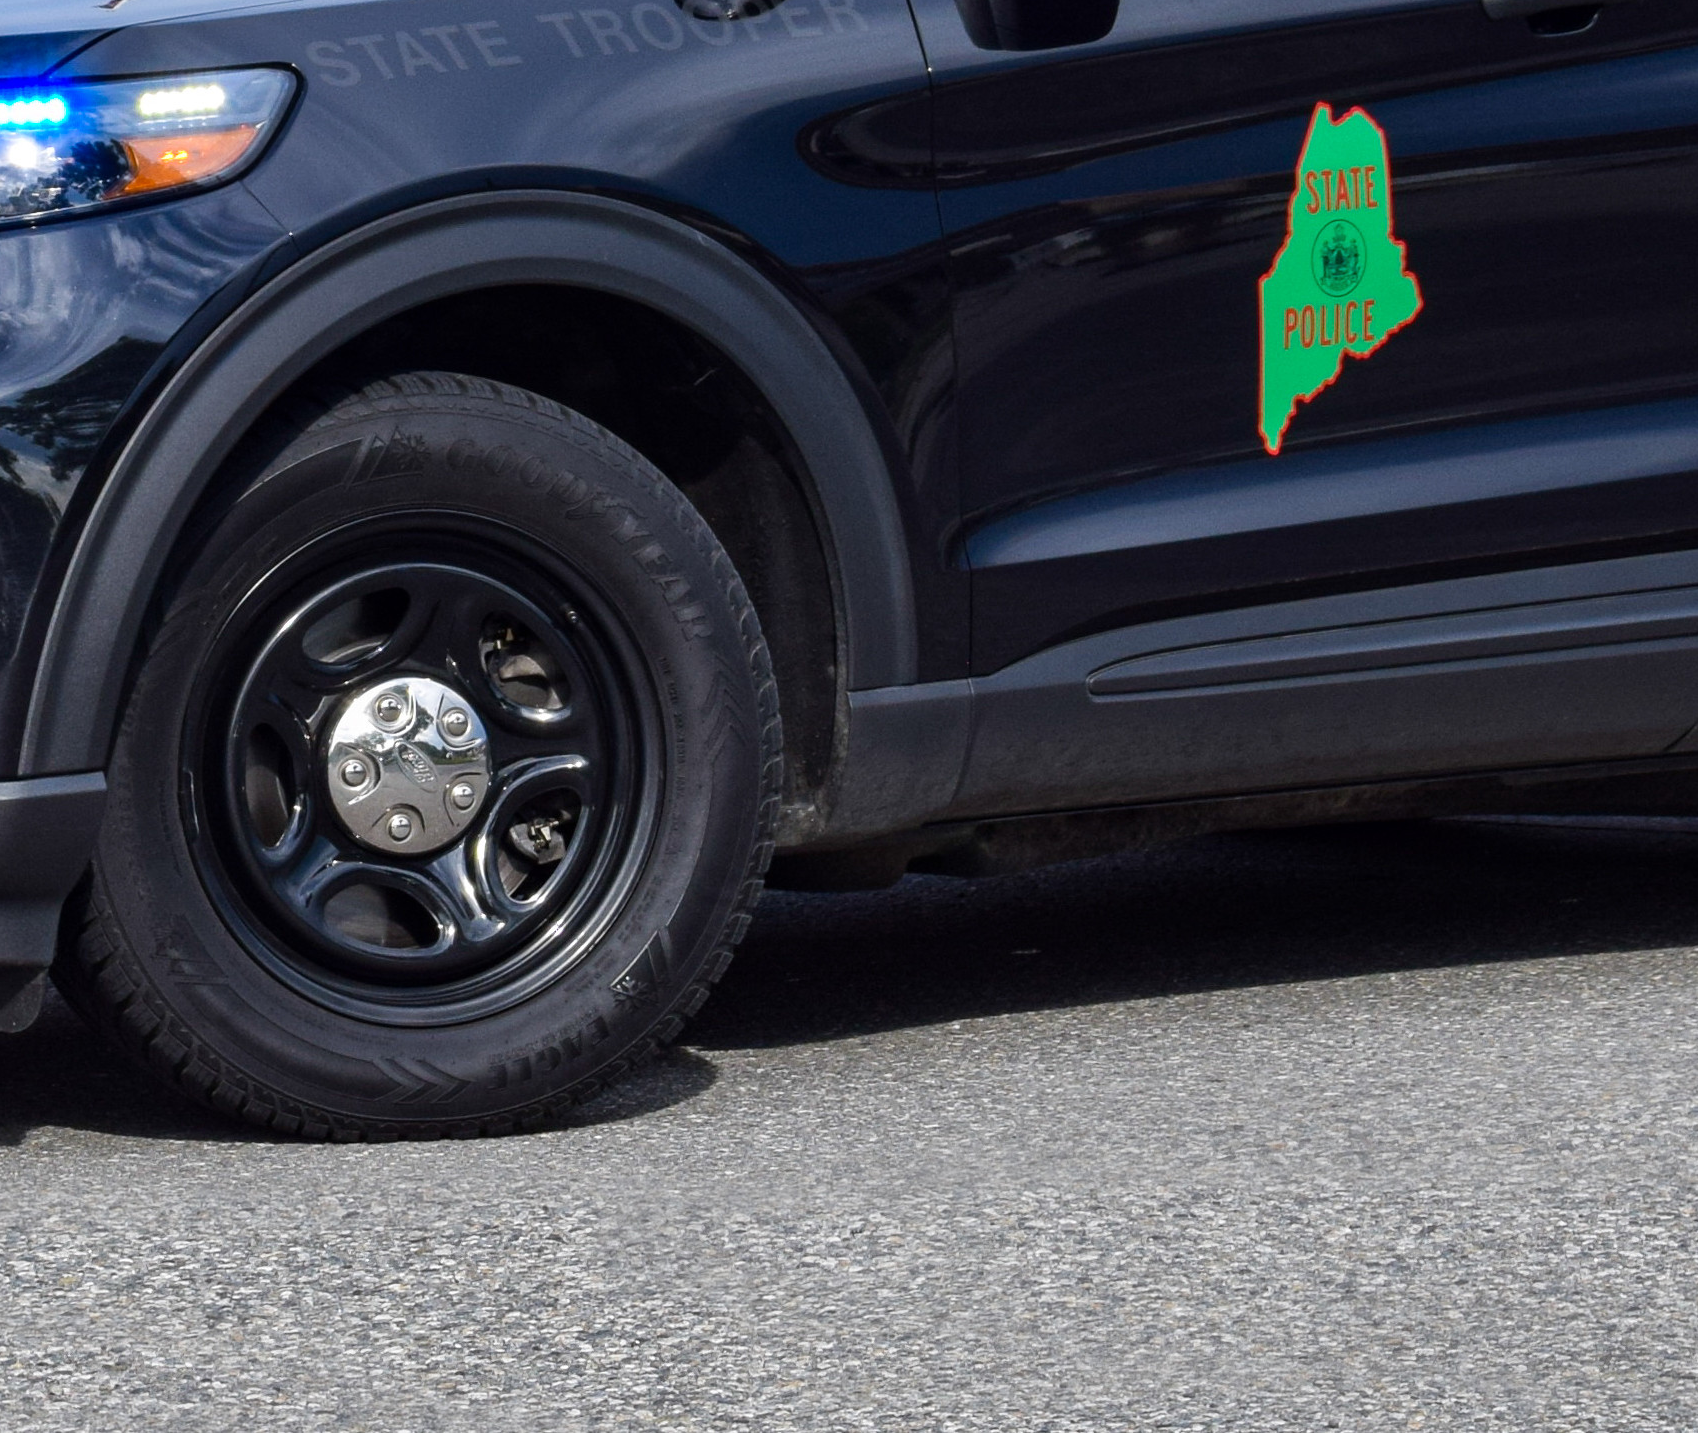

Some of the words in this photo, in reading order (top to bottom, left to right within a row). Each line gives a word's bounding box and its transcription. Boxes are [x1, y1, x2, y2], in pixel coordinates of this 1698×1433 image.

[306, 20, 524, 87] STATE
[1305, 165, 1378, 214] STATE
[1284, 299, 1376, 350] POLICE
[445, 438, 713, 642] GOODYEAR
[487, 1016, 609, 1091] EAGLE
